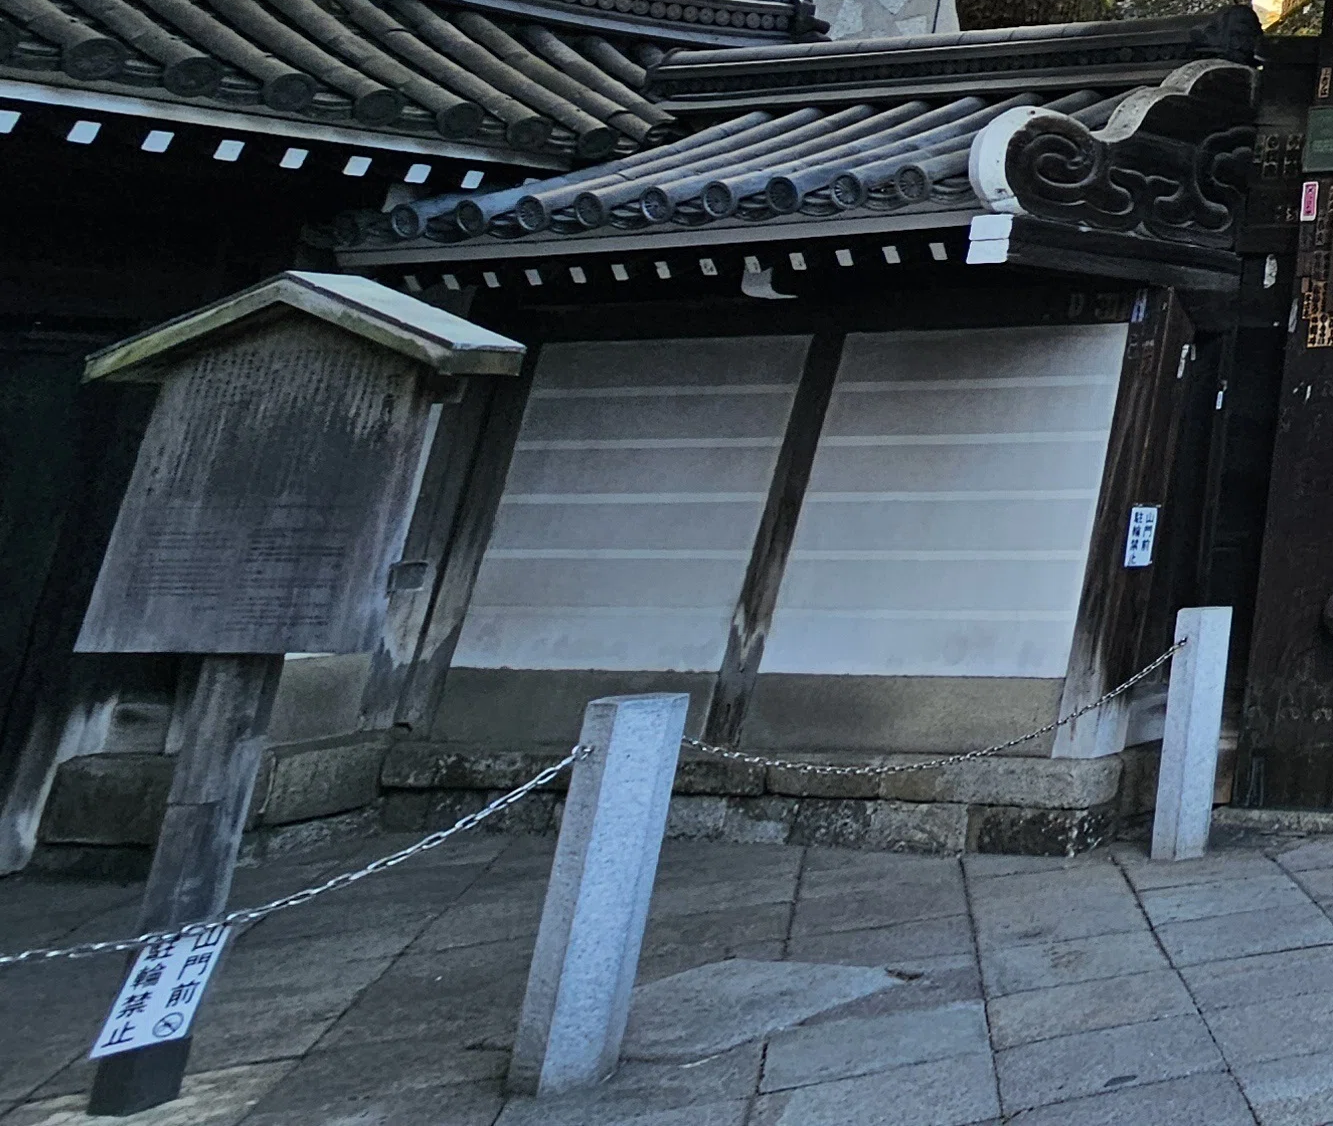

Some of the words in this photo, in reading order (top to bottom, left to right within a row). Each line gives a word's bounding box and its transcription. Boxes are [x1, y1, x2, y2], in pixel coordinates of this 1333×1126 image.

[1128, 511, 1144, 564] 駐輪禁止
[1141, 512, 1155, 551] 山門前
[101, 935, 180, 1049] 駐輪禁止
[165, 924, 227, 1009] 山門前
